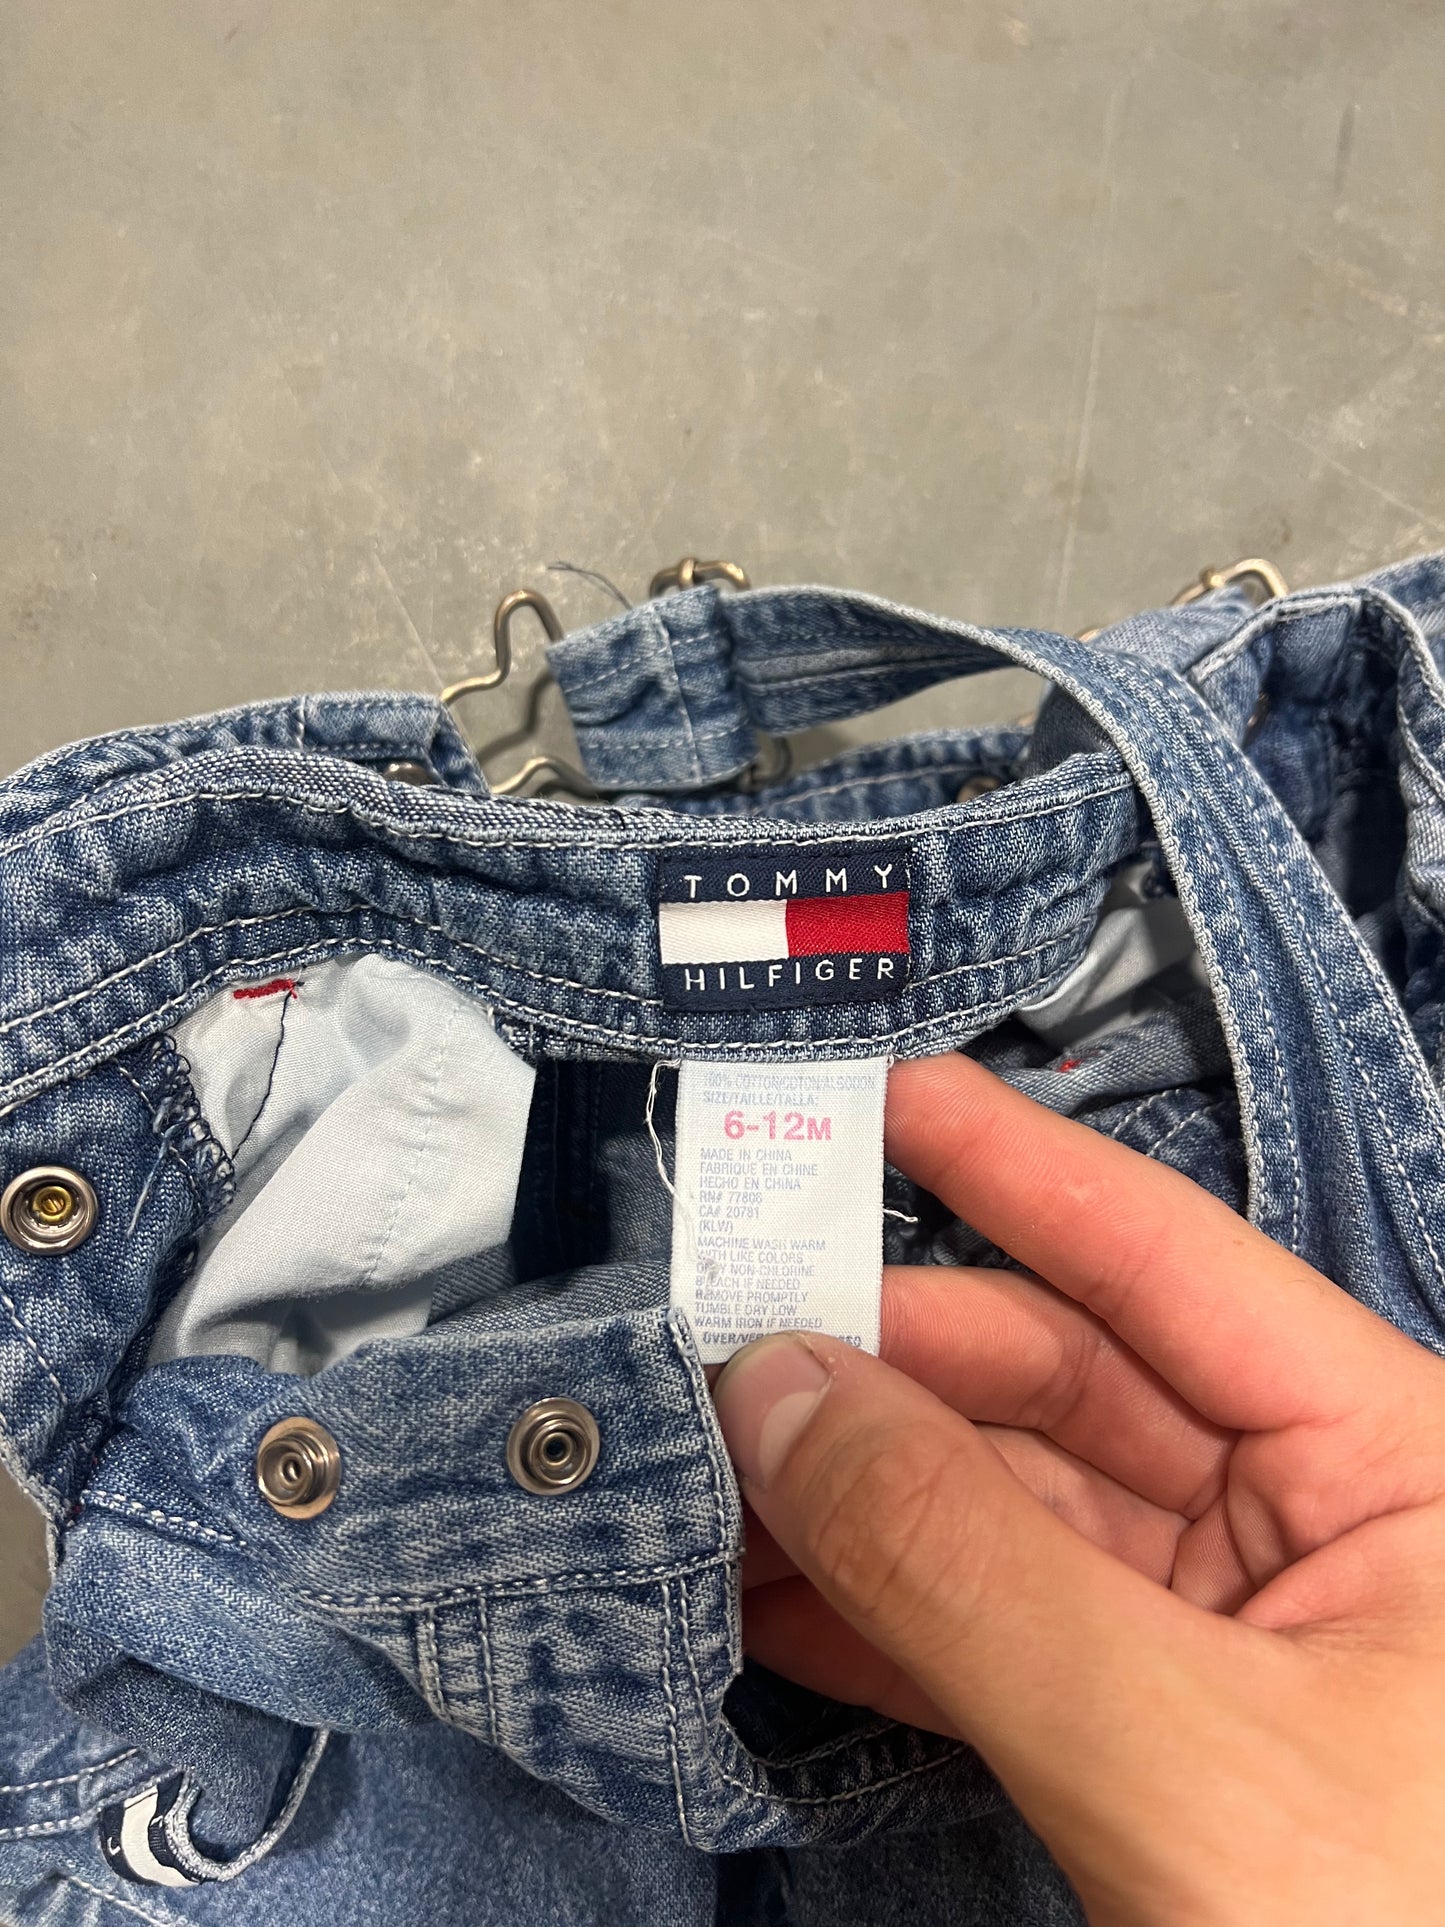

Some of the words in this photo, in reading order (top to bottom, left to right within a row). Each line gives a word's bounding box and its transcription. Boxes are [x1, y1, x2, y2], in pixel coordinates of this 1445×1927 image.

[684, 863, 893, 899] TOMMY
[685, 957, 895, 991] HILFIGER
[724, 1110, 832, 1141] 6-12M
[701, 1148, 733, 1161] MADE
[739, 1148, 751, 1161] IN
[756, 1149, 792, 1162] CHINA
[700, 1162, 757, 1176] FABRIQUE
[762, 1163, 777, 1176] EN
[782, 1164, 818, 1177] CHINE
[700, 1176, 739, 1190] HECHO
[744, 1178, 760, 1190] EN
[765, 1178, 801, 1191] CHINA
[699, 1190, 722, 1204] RN#
[698, 1205, 721, 1218] CA#
[698, 1219, 733, 1234] (KLW)
[697, 1237, 750, 1249] MACHINE
[753, 1238, 788, 1250] WASH
[791, 1239, 826, 1251] WARM
[730, 1251, 755, 1263] LIKE
[758, 1252, 804, 1265] COLORS
[744, 1278, 755, 1289] IF
[757, 1279, 801, 1291] NEEDED
[747, 1292, 809, 1304] PROMPTLY
[695, 1303, 741, 1315] TUMBLE
[746, 1306, 770, 1317] DRY
[773, 1306, 798, 1317] LOW
[695, 1318, 732, 1330] WARM
[736, 1319, 763, 1330] IRON
[767, 1319, 777, 1330] IF
[779, 1319, 823, 1331] NEEDED
